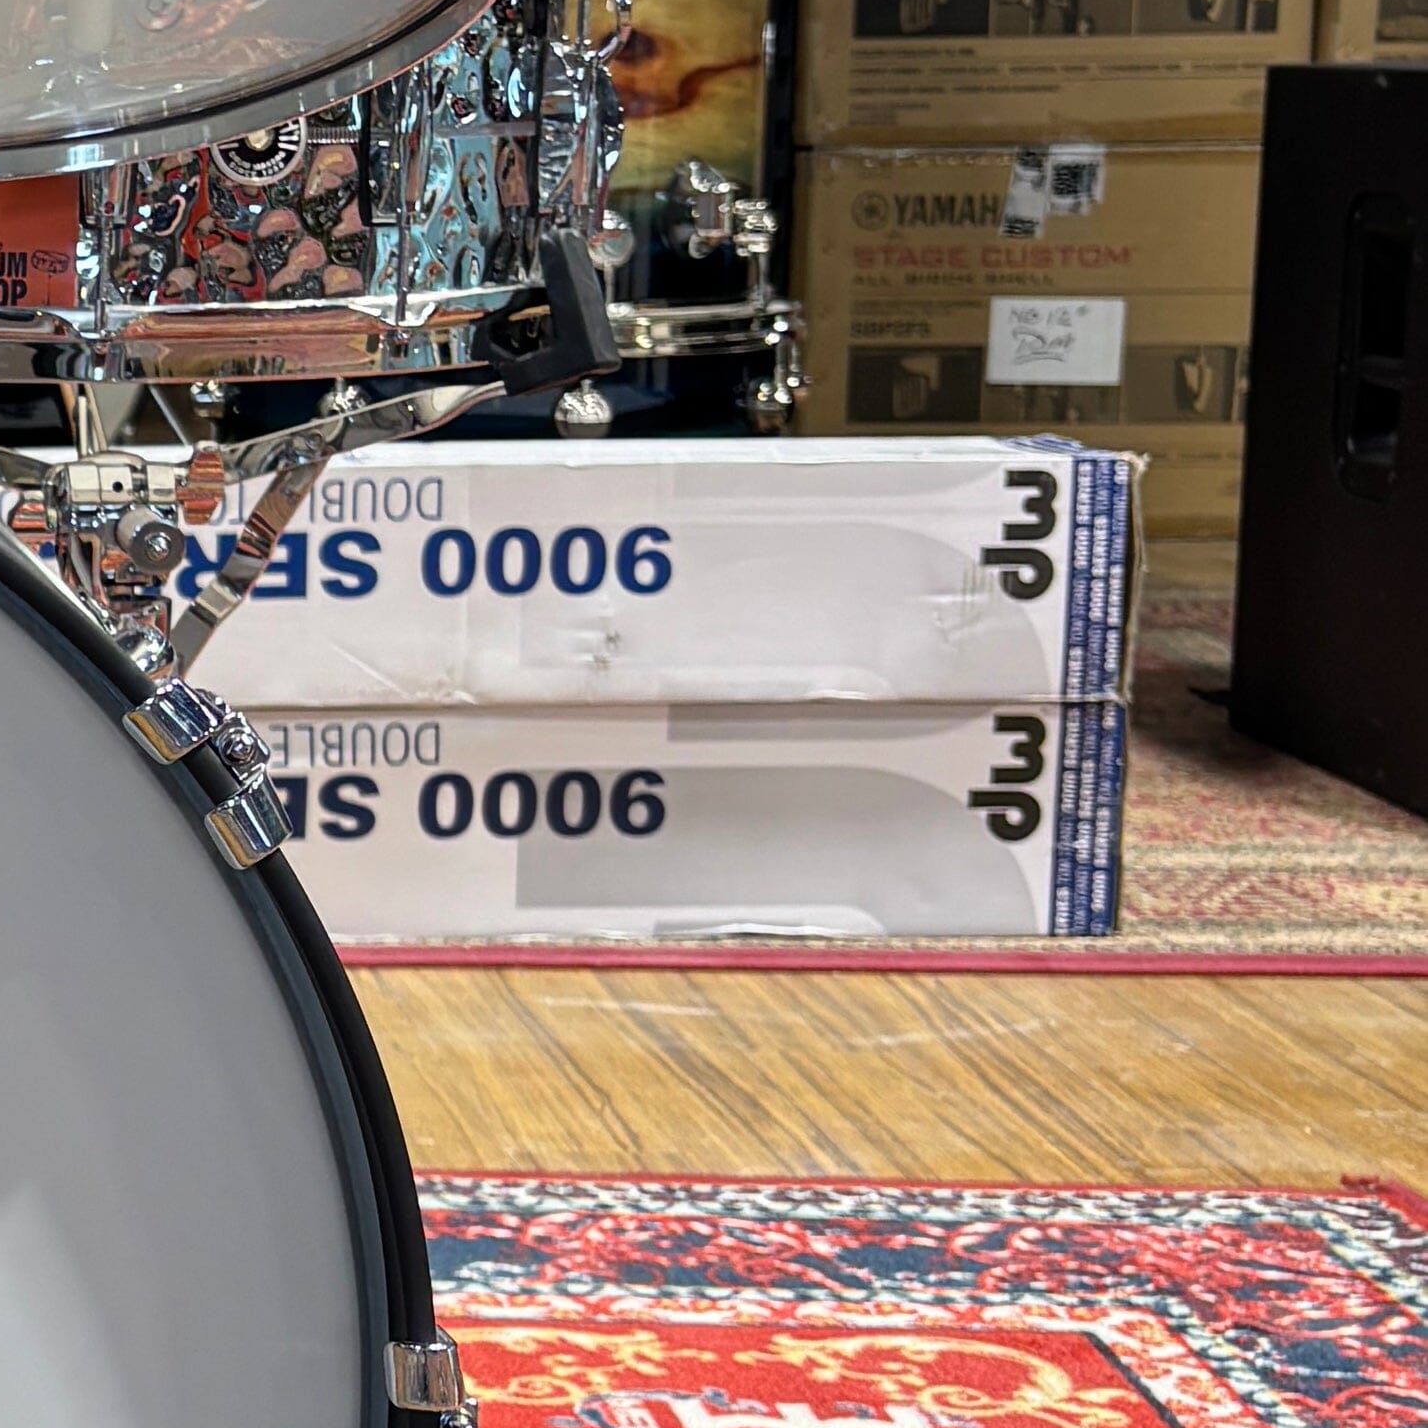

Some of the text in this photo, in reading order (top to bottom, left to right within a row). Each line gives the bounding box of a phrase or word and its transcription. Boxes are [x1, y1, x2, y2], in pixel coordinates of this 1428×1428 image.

[852, 243, 1134, 270] STAGE CUSTOM
[309, 476, 443, 523] DOUBL
[421, 525, 673, 599] 9000
[981, 470, 1058, 601] dw
[268, 721, 441, 768] DOUBLE
[969, 715, 1048, 843] dw
[417, 768, 667, 839] 9000
